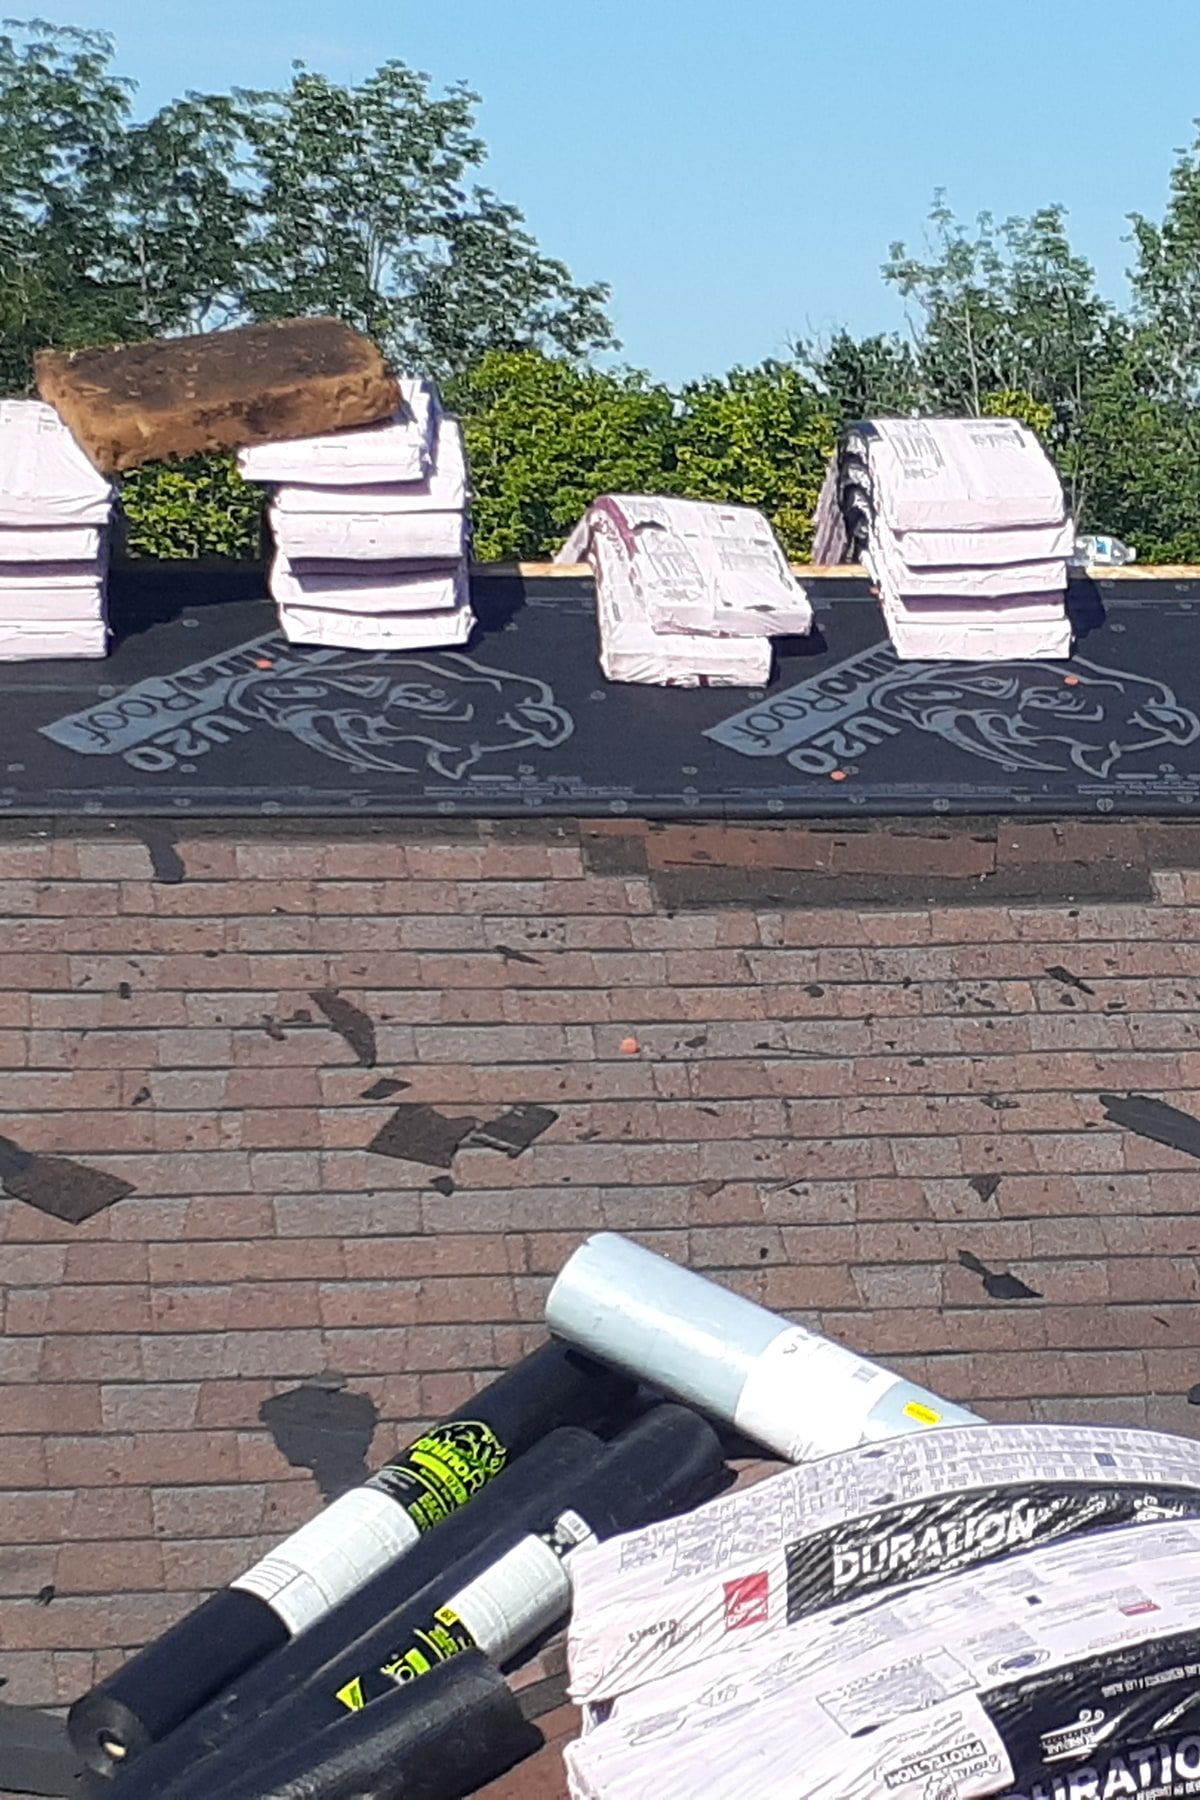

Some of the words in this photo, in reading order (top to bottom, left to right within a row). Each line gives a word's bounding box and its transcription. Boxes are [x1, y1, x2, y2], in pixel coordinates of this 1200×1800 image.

[72, 637, 302, 746] hinoRoof
[731, 646, 899, 749] inoRoof
[122, 714, 251, 772] U20
[786, 715, 901, 774] U20
[832, 1504, 1036, 1586] DURATION
[886, 1742, 984, 1786] PROTECTION
